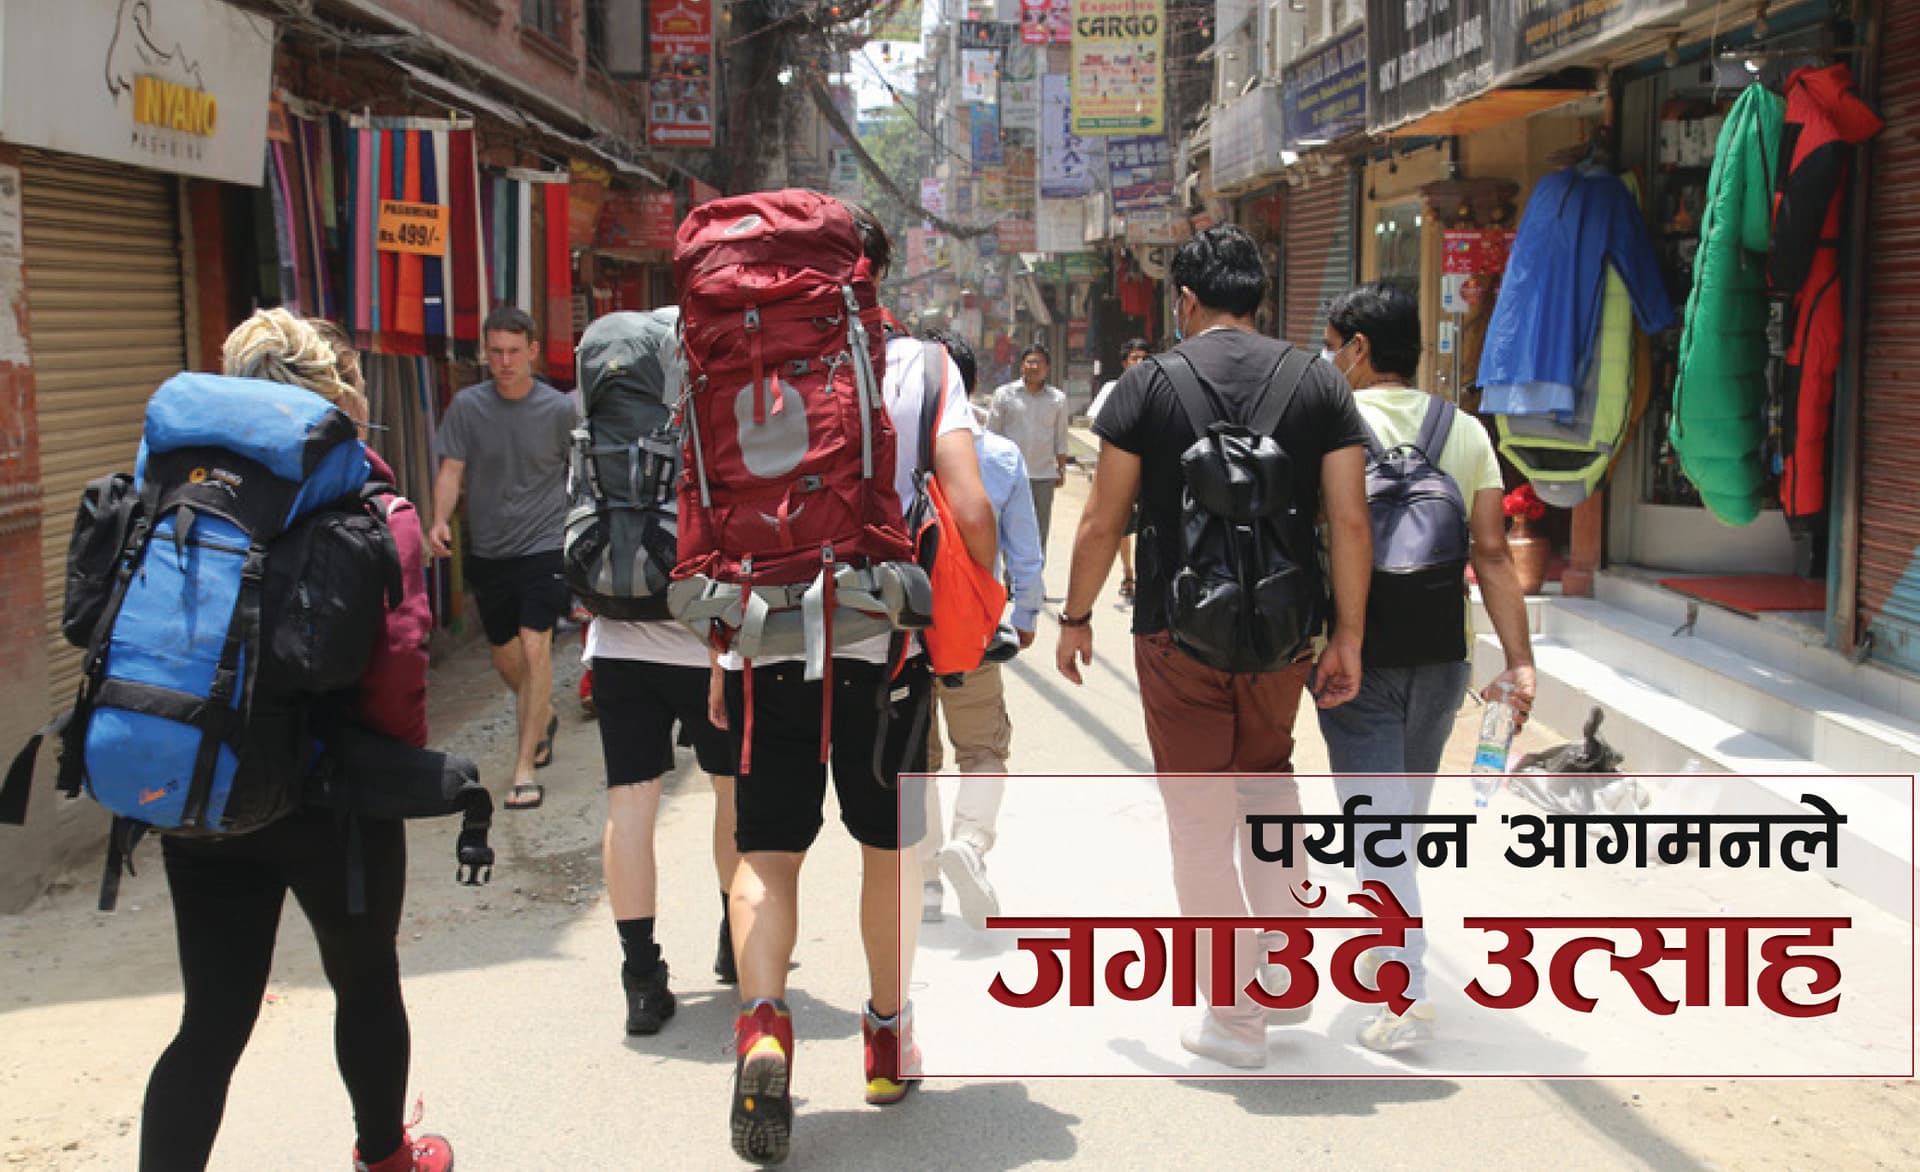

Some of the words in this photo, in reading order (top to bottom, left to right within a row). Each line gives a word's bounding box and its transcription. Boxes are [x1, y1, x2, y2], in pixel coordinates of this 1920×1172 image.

[1077, 14, 1158, 37] CARGO
[136, 75, 218, 138] NYANO
[399, 223, 440, 248] 499/-
